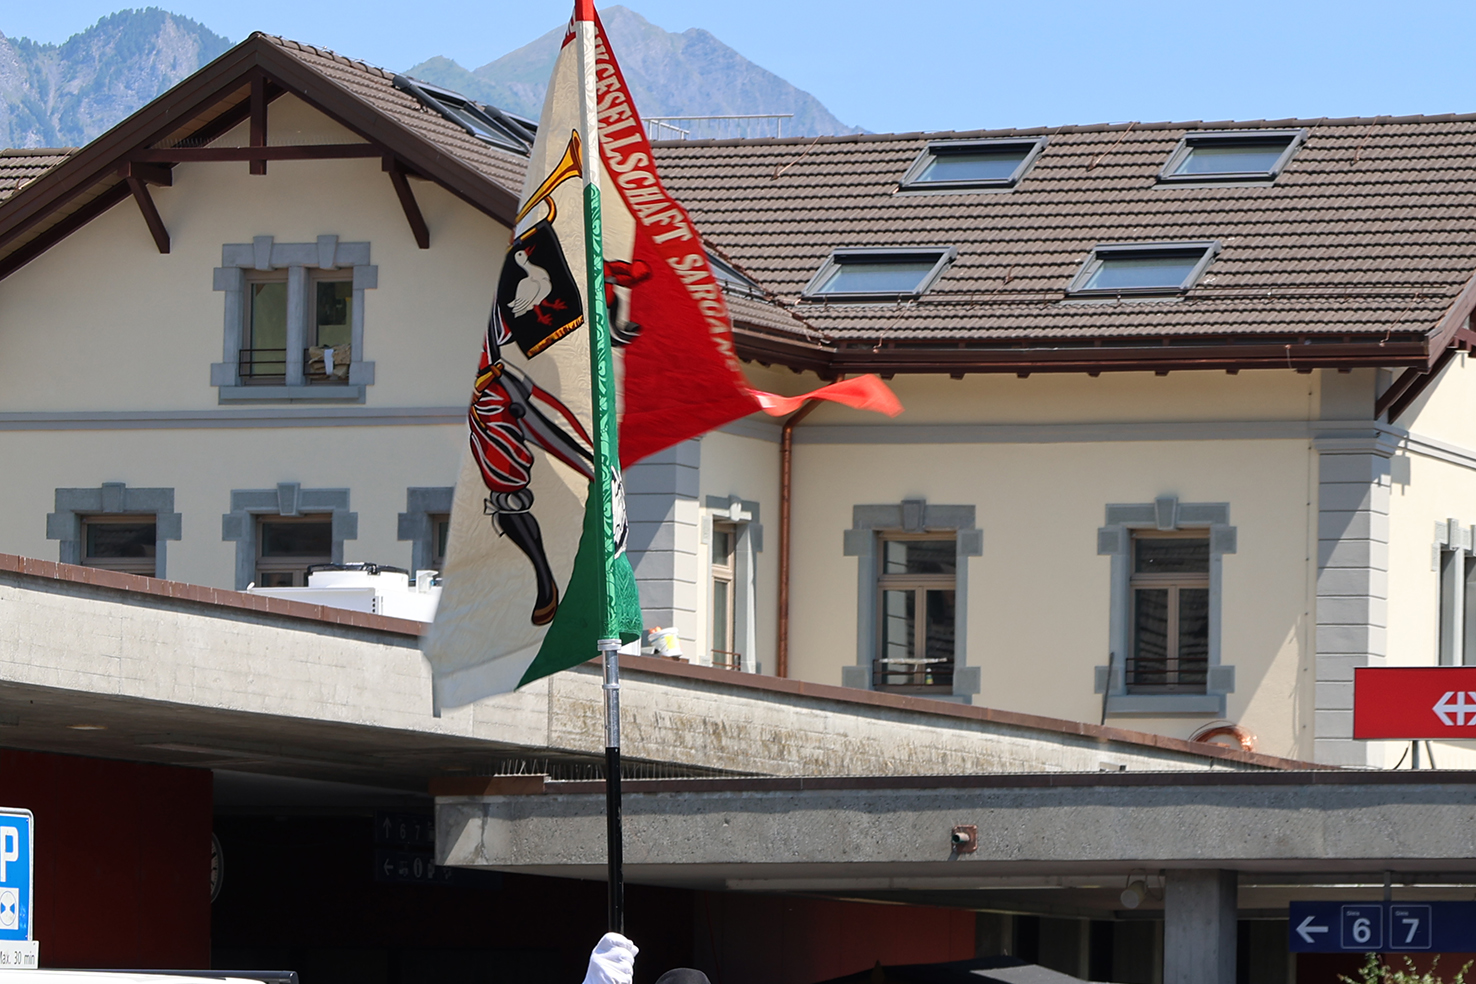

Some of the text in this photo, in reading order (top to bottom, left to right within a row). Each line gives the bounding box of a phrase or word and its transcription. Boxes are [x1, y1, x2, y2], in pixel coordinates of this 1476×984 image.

[0, 826, 19, 882] P
[1353, 918, 1371, 943] 6
[1402, 918, 1420, 943] 7
[14, 950, 22, 965] 30
[24, 950, 36, 965] min
